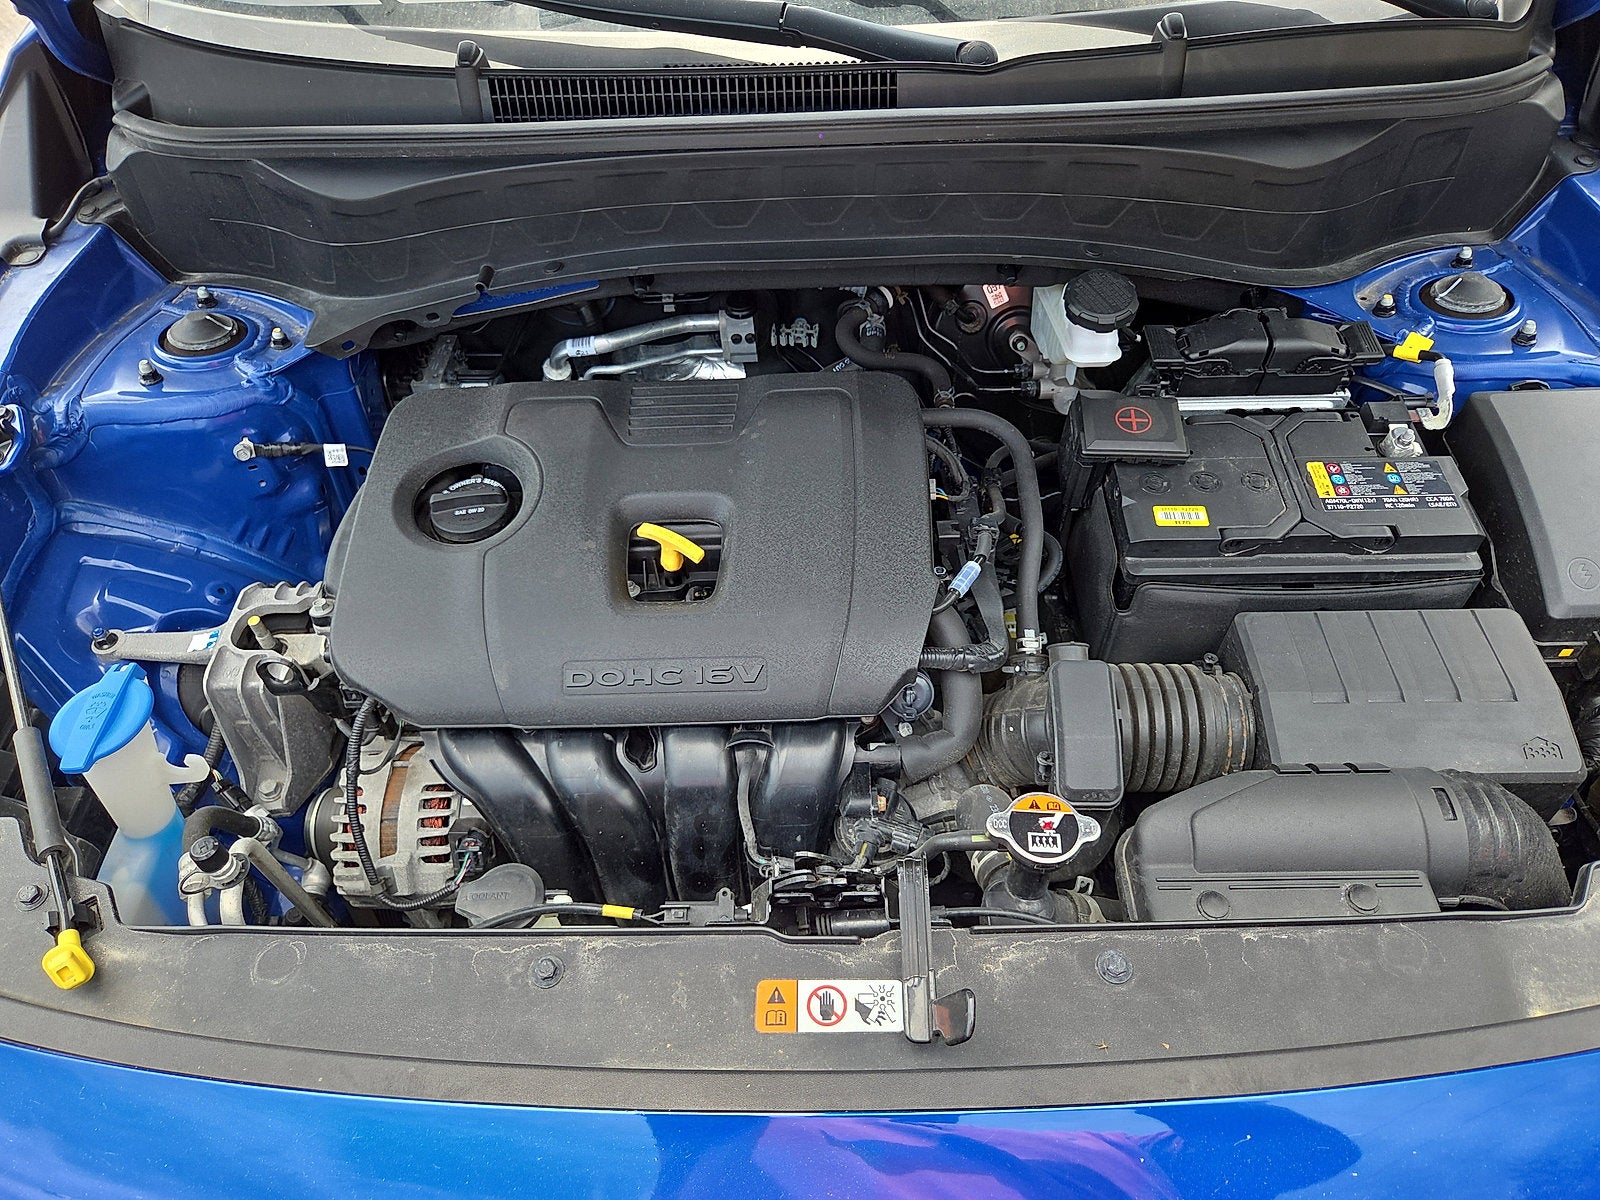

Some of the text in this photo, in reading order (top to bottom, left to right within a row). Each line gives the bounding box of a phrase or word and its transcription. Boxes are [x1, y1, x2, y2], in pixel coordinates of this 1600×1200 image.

[566, 664, 765, 688] DOHC 16V
[465, 891, 510, 900] COOLANT
